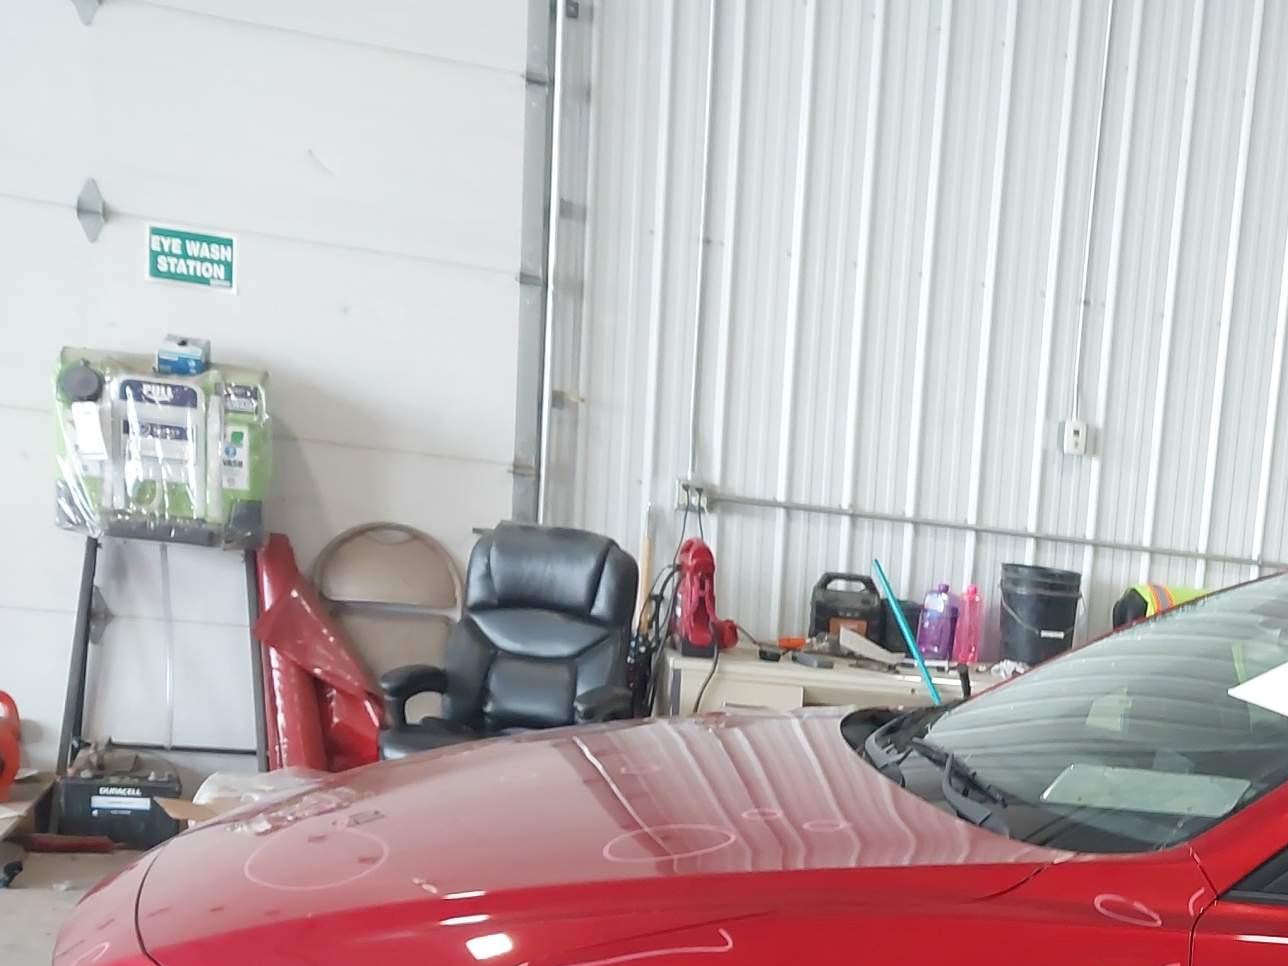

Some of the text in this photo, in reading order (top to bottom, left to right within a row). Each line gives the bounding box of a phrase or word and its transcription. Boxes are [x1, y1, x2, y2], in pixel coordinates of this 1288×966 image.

[151, 234, 232, 263] EYE WASH
[157, 255, 225, 280] STATION
[99, 786, 142, 797] DURACELL
